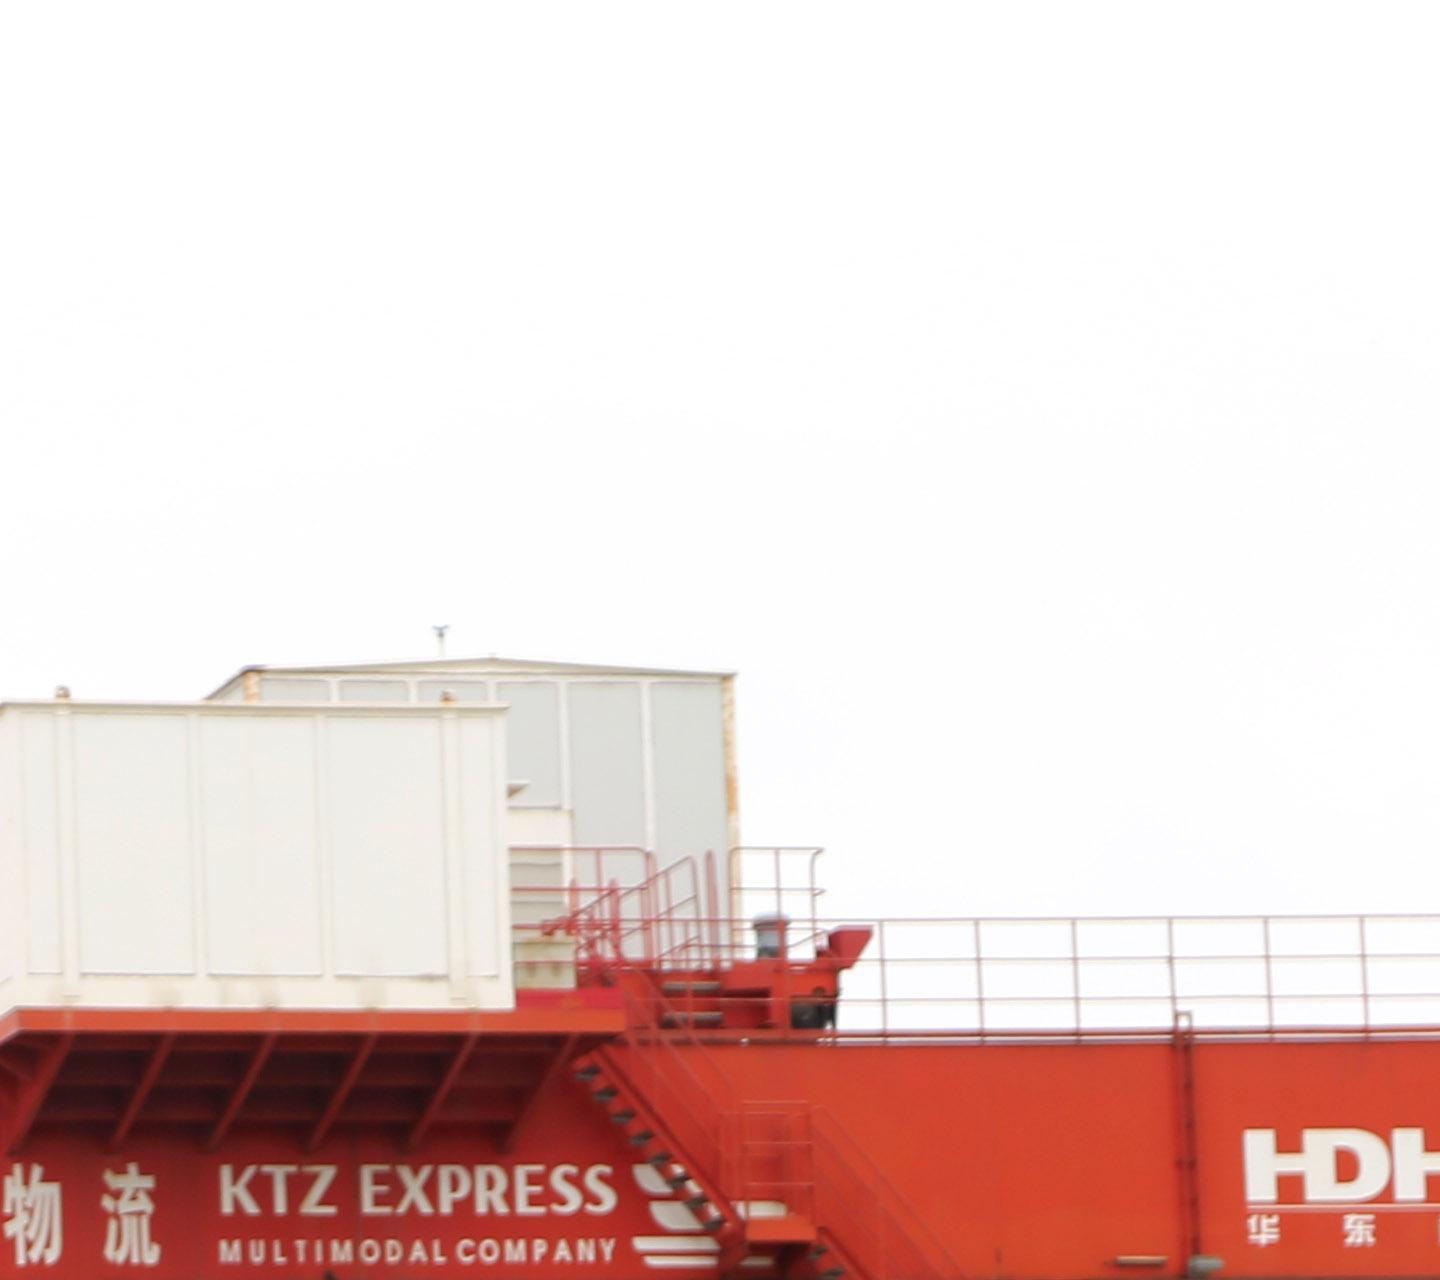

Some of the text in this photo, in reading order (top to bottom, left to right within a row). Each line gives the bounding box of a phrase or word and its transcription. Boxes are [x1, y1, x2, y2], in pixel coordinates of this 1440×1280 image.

[219, 1162, 618, 1217] KTZ EXPRESS
[219, 1236, 618, 1267] MULTIMODAL COMPANY
